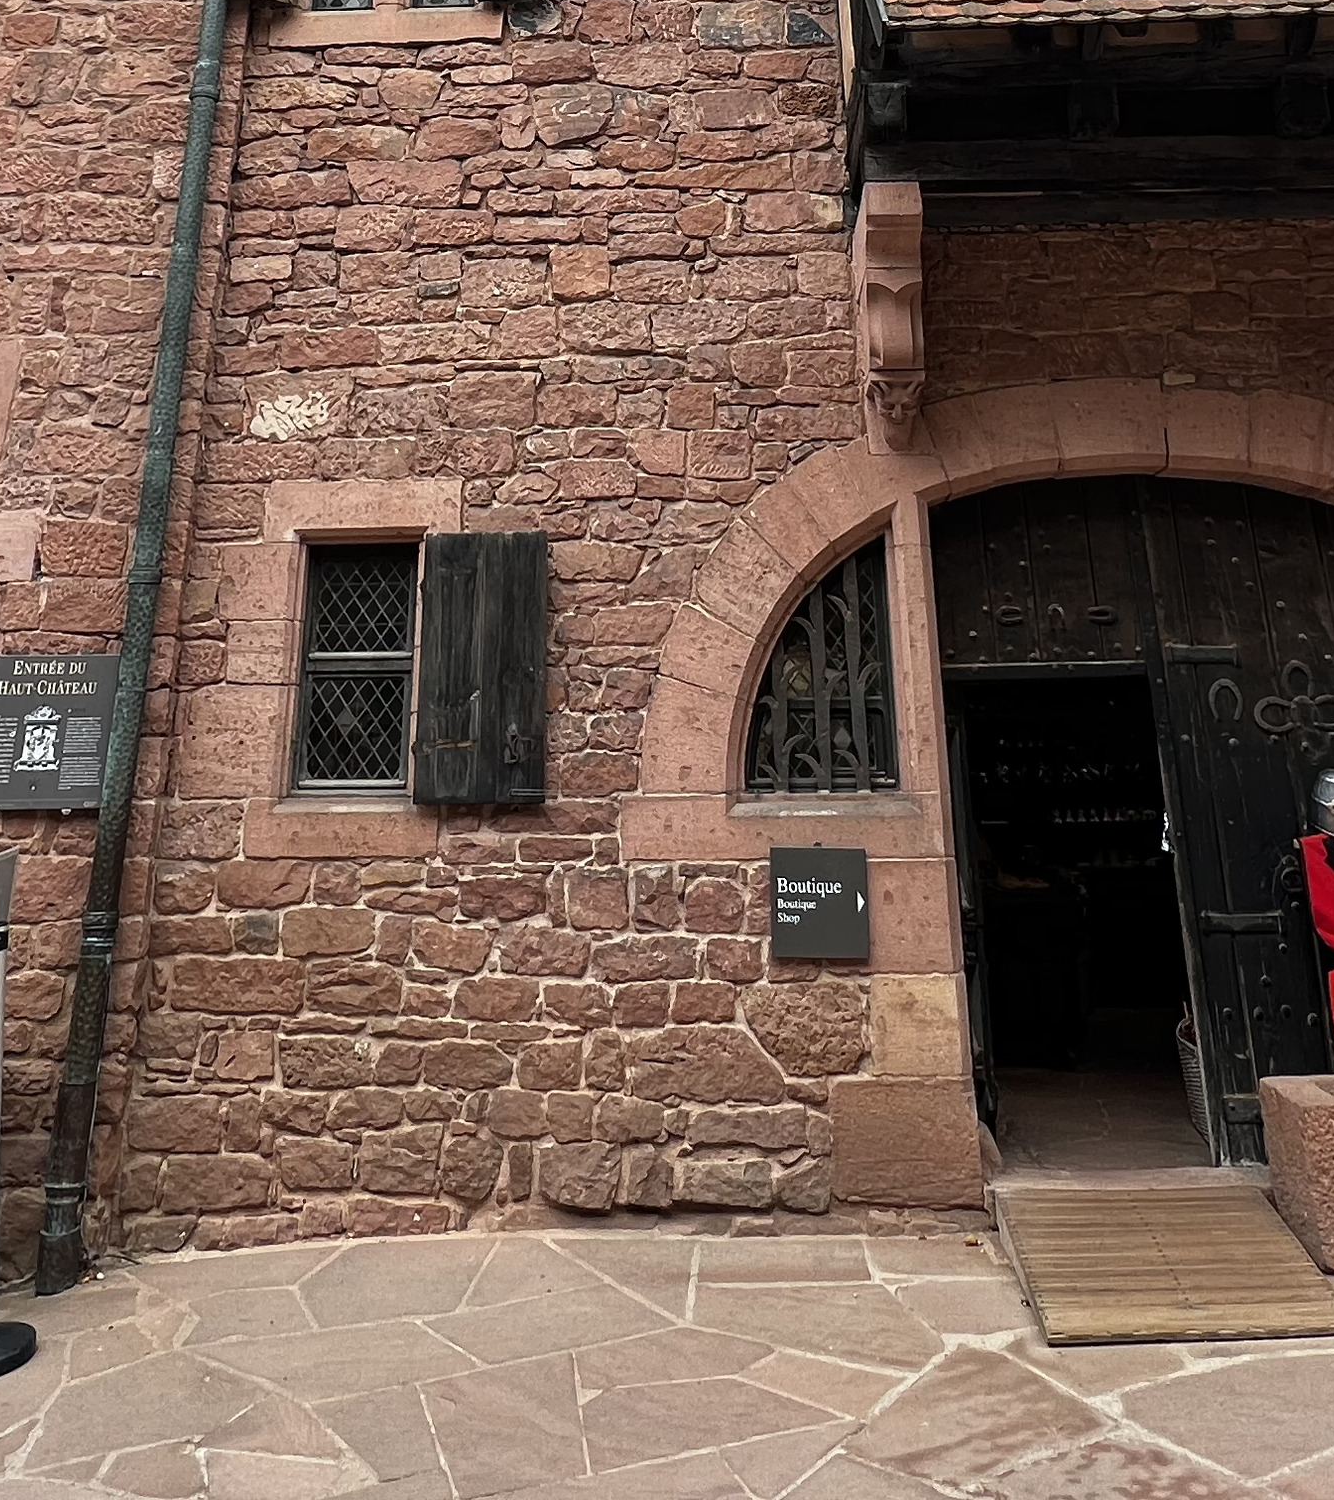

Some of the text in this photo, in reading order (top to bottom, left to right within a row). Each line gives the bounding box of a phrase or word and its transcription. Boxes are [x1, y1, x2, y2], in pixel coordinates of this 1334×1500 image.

[13, 659, 87, 675] ENTRÉE DU
[776, 877, 842, 899] Boutique
[777, 898, 817, 912] Boutique
[777, 912, 801, 925] Shop
